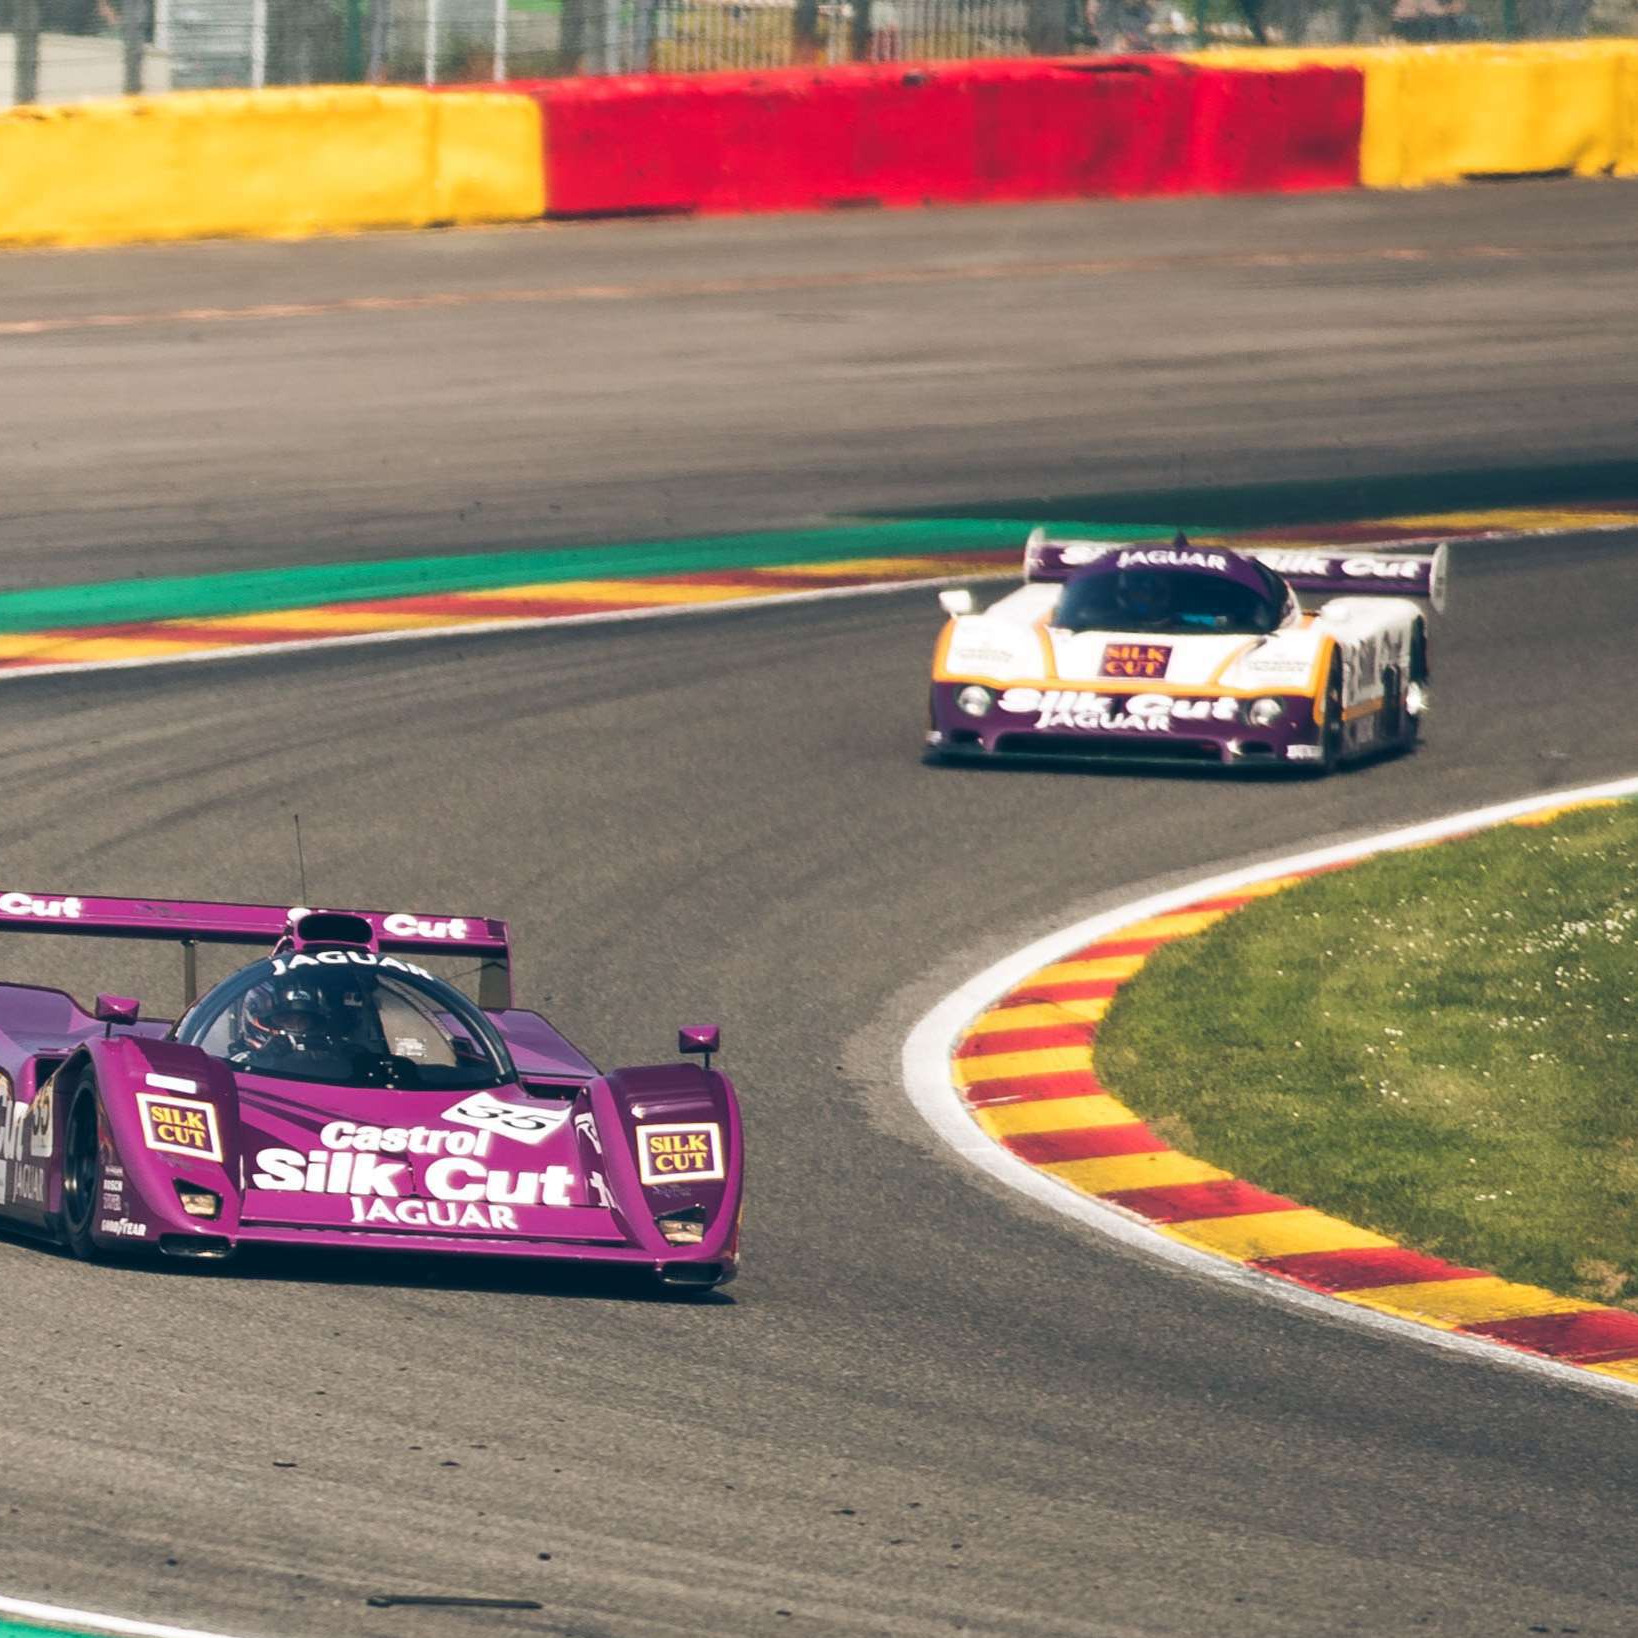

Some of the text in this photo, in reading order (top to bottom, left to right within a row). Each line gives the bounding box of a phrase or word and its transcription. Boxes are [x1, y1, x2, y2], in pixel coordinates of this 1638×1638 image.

[1116, 550, 1226, 571] JAGUAR
[1341, 557, 1419, 579] Cut
[1106, 647, 1165, 662] SILK
[1105, 661, 1159, 675] CUT
[998, 687, 1239, 719] Silk Cut
[1034, 711, 1170, 731] JAGUAR
[383, 913, 468, 939] Cut
[272, 951, 434, 981] JAGUAR
[150, 1105, 206, 1130] SILK
[457, 1103, 555, 1131] 35
[157, 1124, 206, 1148] CUT
[320, 1121, 491, 1157] Castrol
[649, 1134, 709, 1154] SILK
[655, 1151, 708, 1172] CUT
[253, 1148, 573, 1206] Silk Cut
[350, 1197, 519, 1230] JAGUAR
